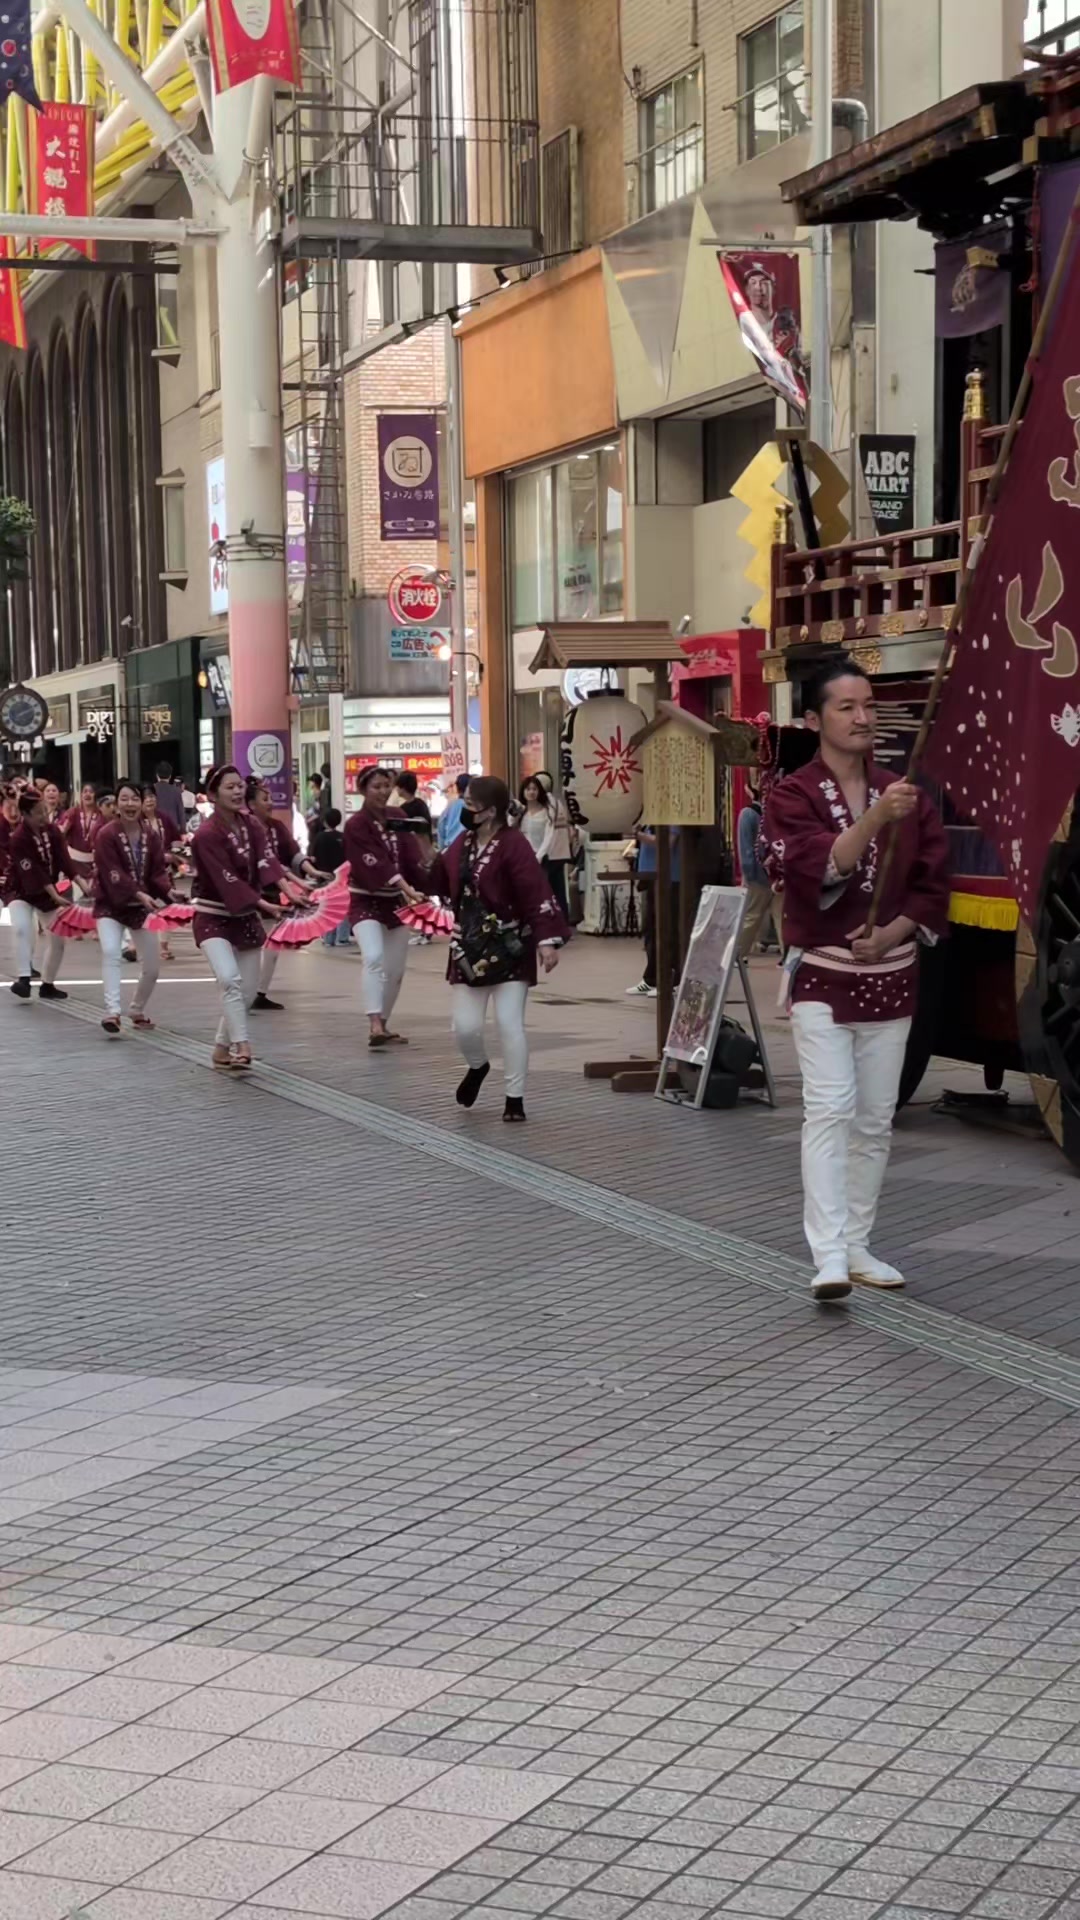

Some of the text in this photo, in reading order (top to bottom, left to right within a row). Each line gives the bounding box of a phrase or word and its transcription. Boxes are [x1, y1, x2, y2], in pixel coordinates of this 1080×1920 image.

[864, 450, 910, 475] ABC
[865, 476, 910, 493] MART
[400, 587, 437, 607] 消火栓
[398, 740, 430, 751] bellus
